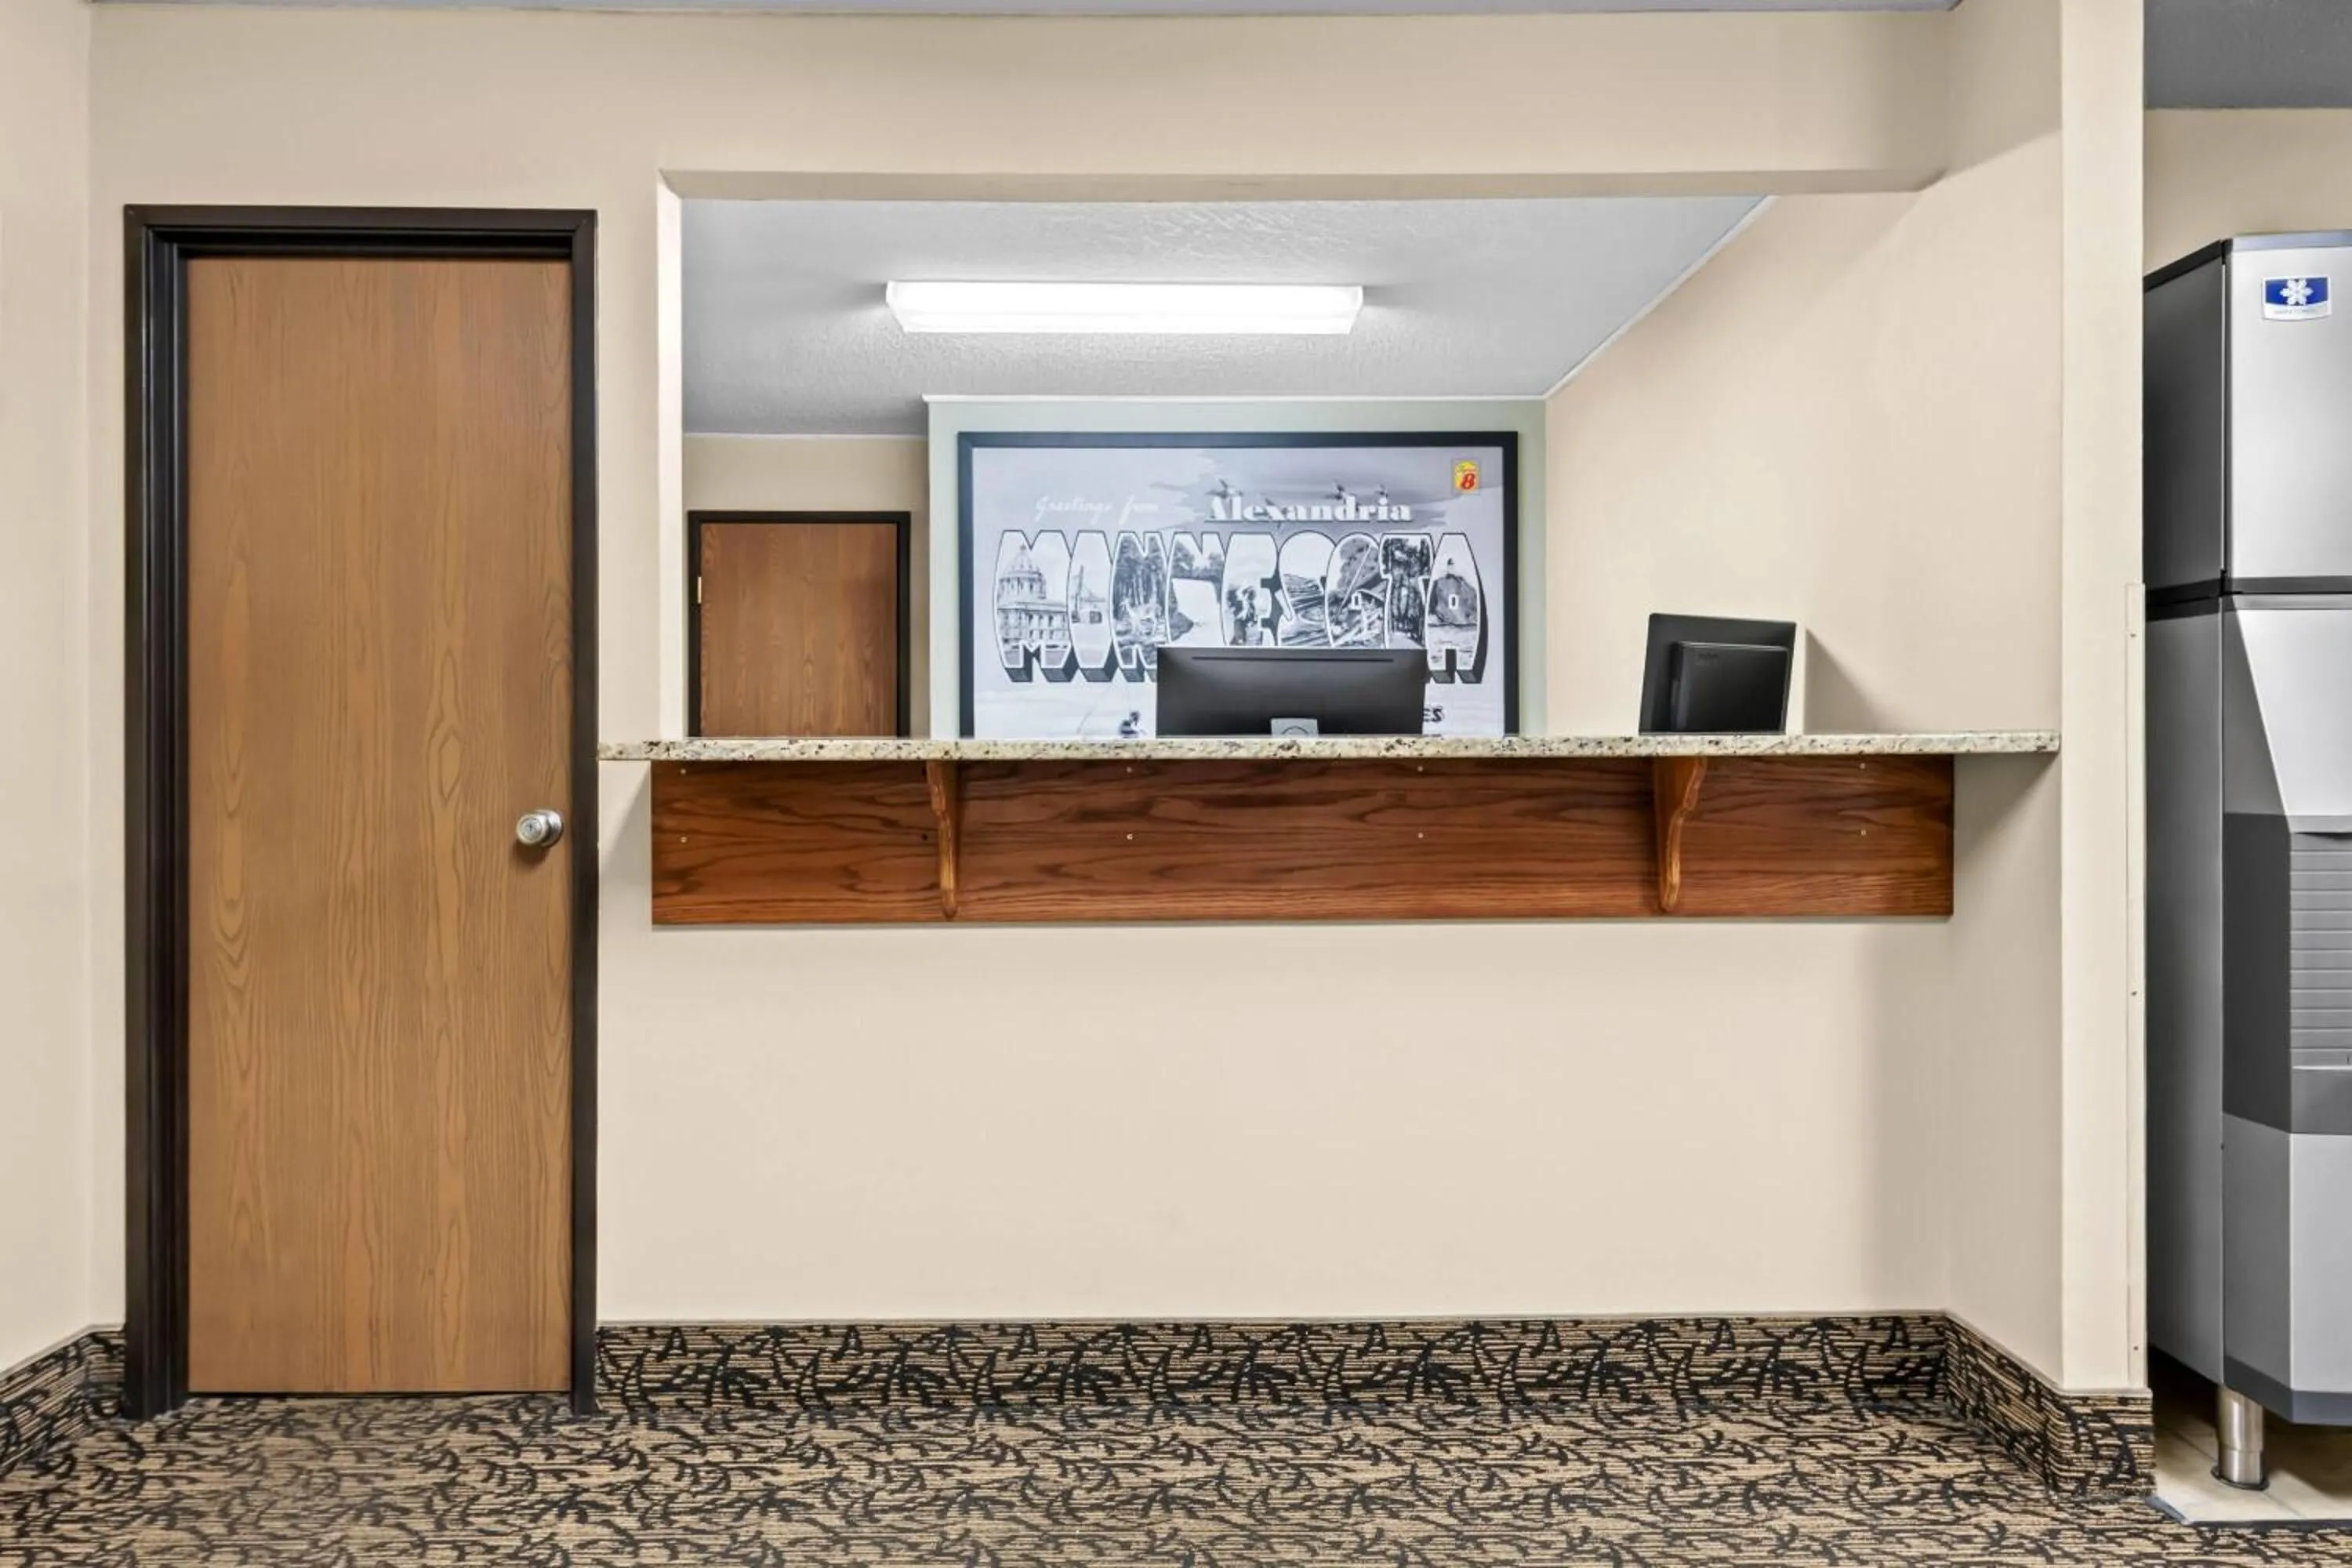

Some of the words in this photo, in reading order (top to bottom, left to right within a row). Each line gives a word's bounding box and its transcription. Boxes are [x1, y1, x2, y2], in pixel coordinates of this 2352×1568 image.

[1461, 472, 1475, 490] 8
[1208, 492, 1414, 522] Alexandria
[994, 530, 1486, 683] MINNESOTA
